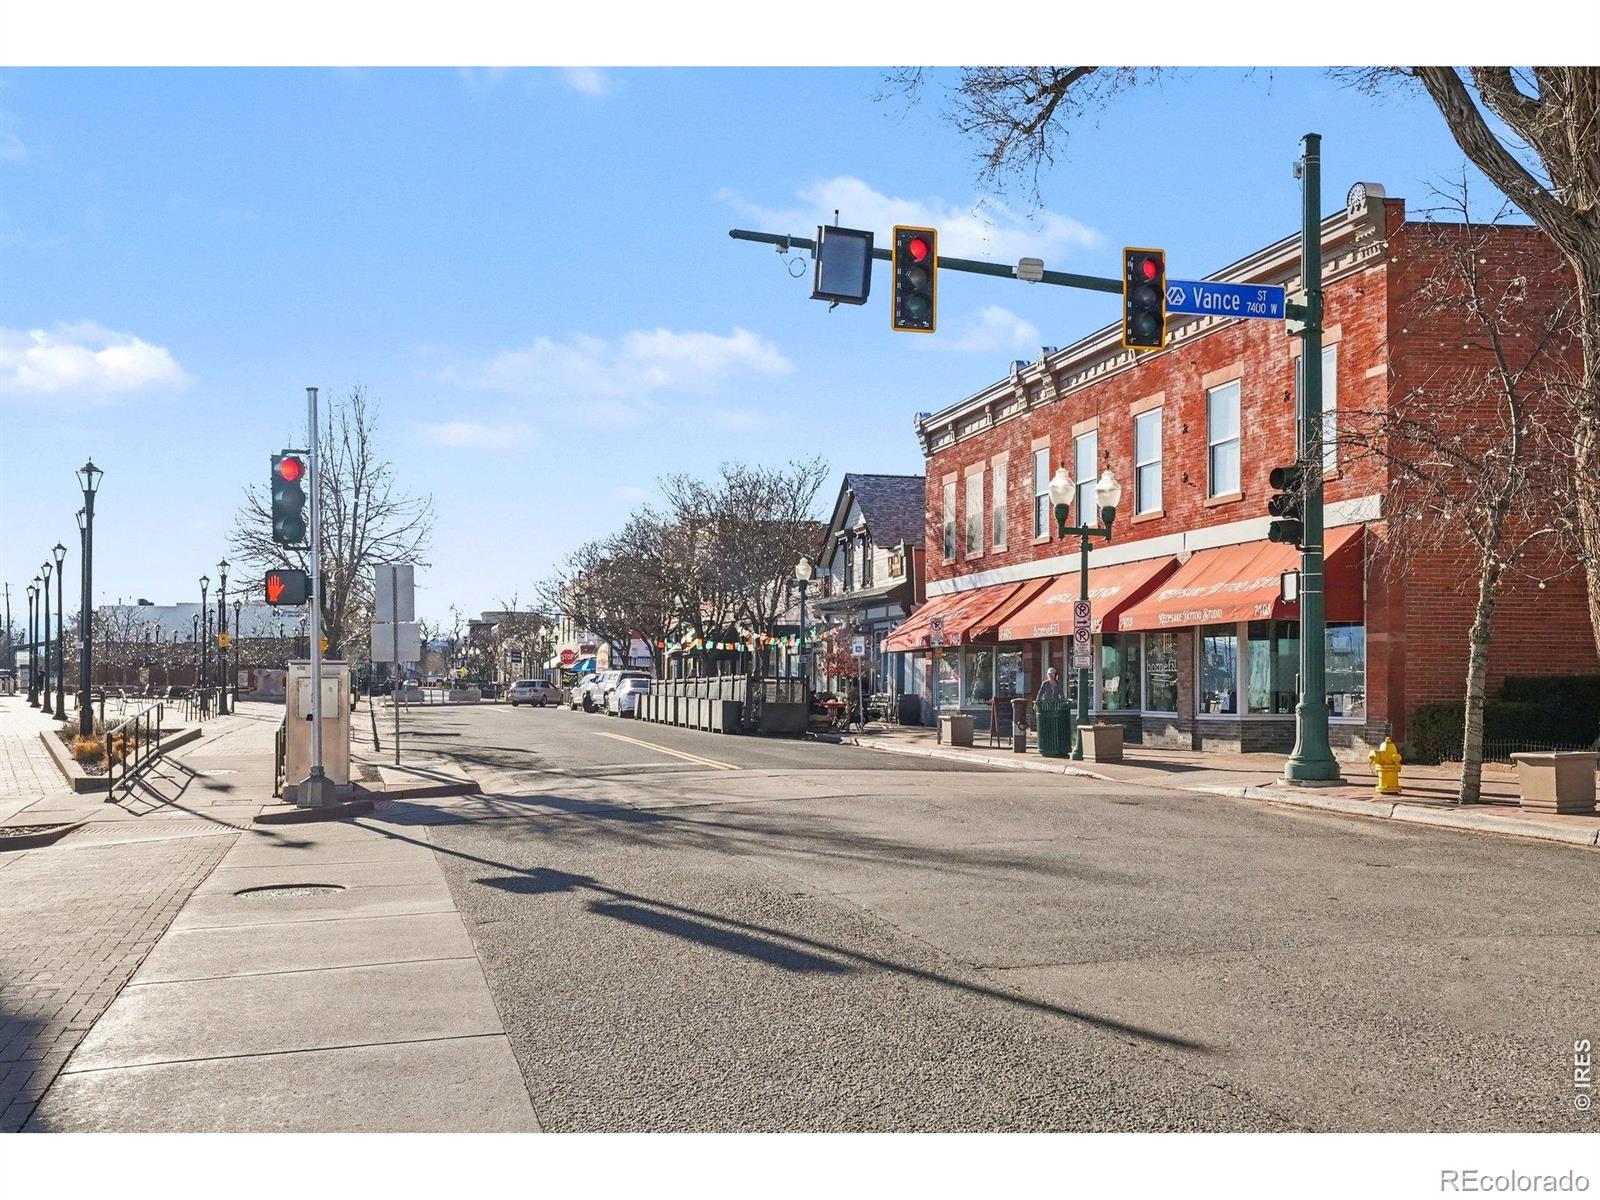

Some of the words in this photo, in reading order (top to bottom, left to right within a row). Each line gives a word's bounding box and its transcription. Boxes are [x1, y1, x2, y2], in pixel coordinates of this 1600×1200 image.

[1193, 287, 1240, 310] Vance
[1257, 290, 1267, 301] ST
[1247, 302, 1266, 313] 7400
[1270, 304, 1278, 314] W
